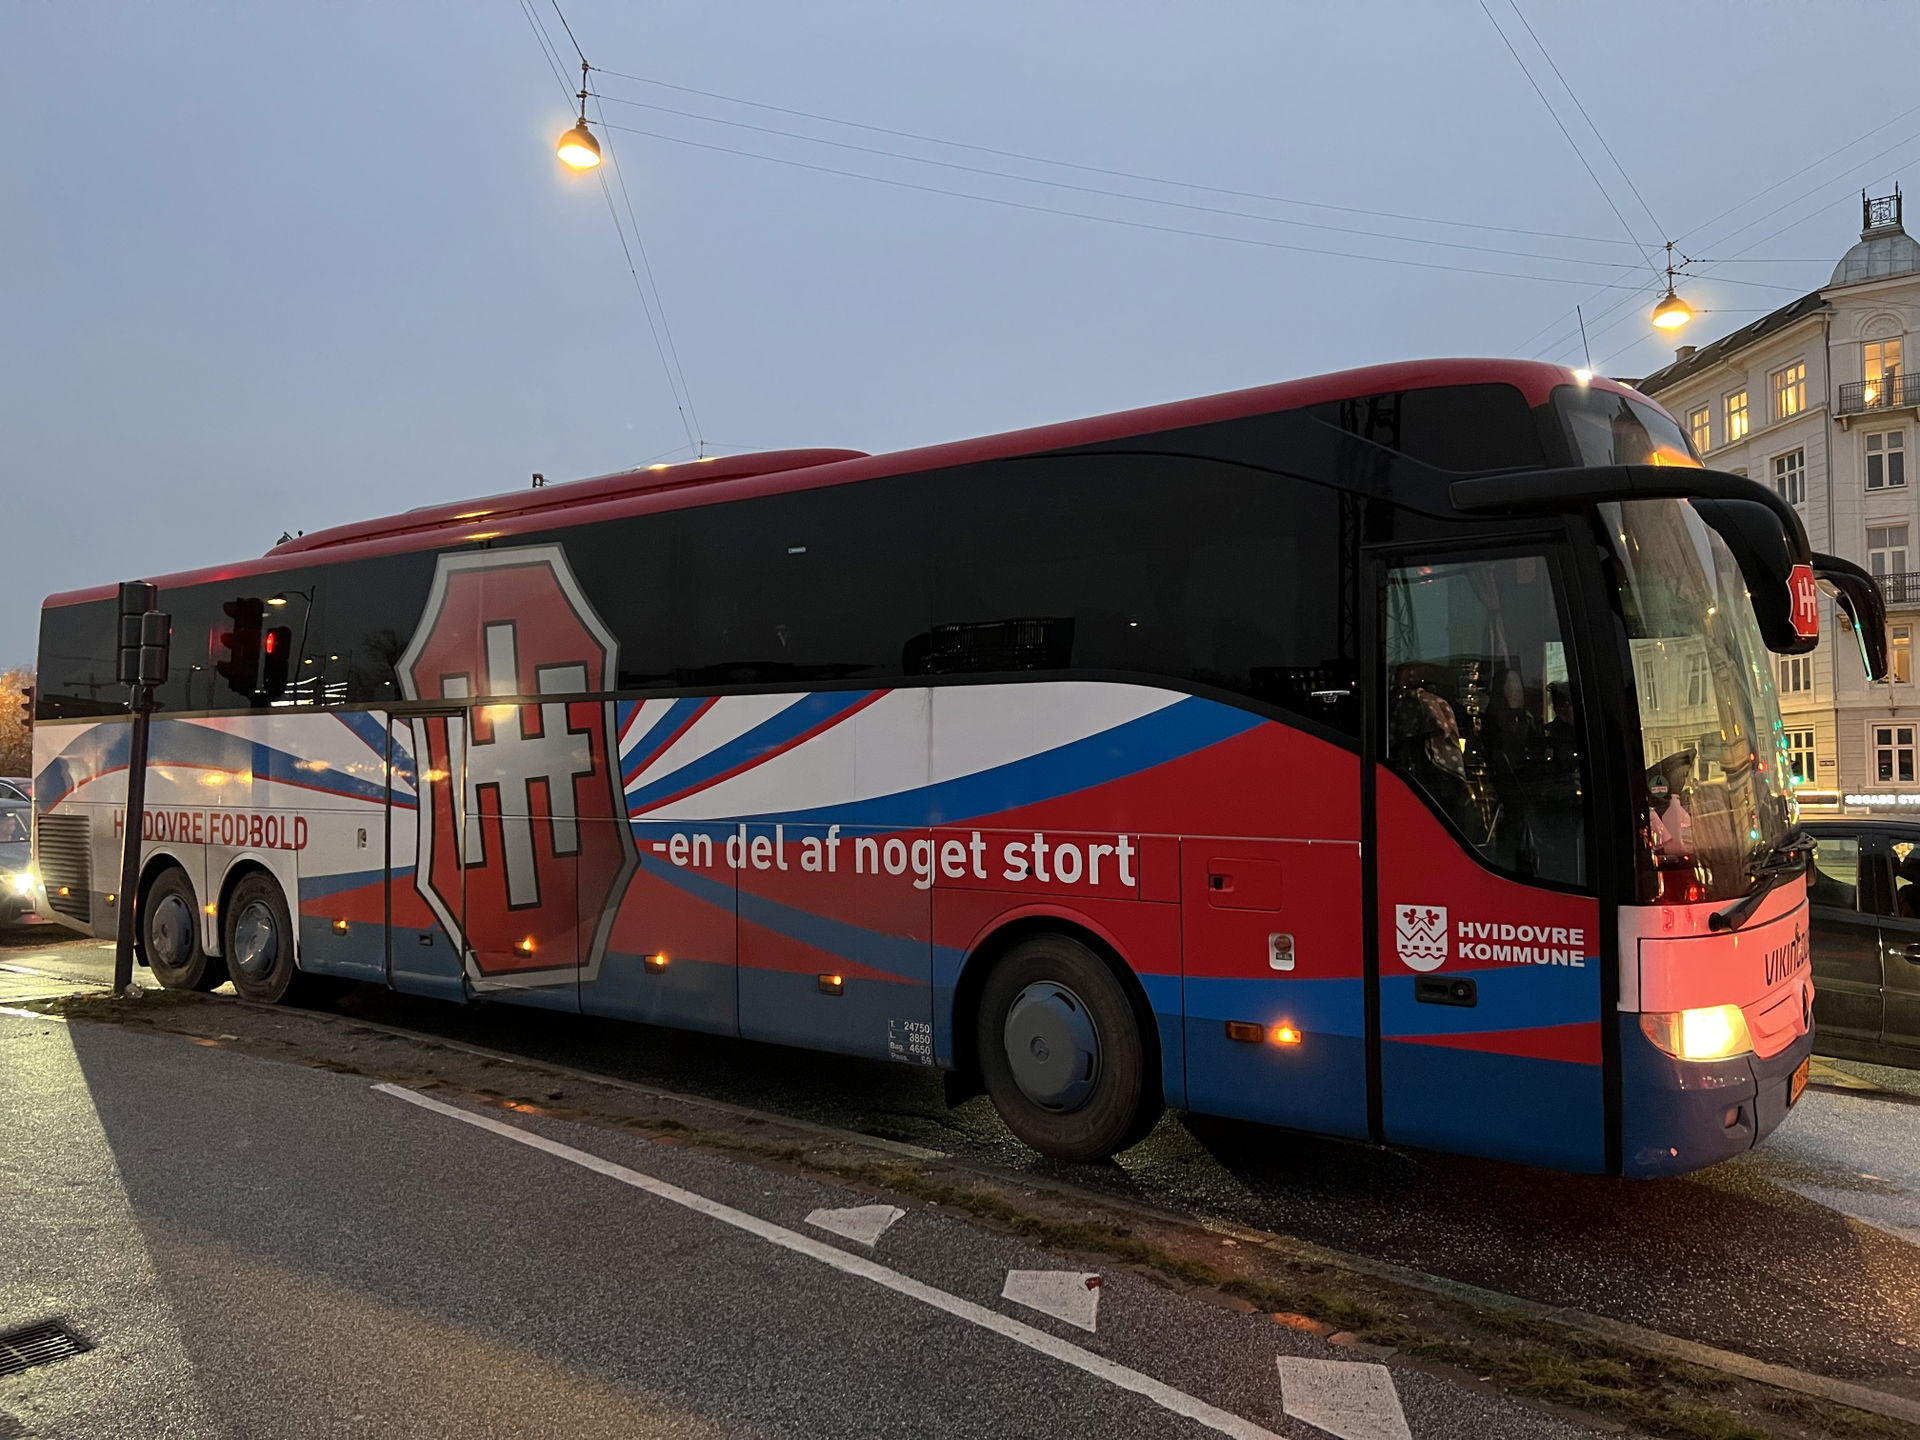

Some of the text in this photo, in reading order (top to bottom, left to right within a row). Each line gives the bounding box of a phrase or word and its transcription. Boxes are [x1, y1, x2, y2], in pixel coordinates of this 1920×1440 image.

[114, 809, 309, 850] HDOVRE FODBOLD
[726, 823, 788, 871] del
[800, 824, 841, 873] af
[855, 831, 988, 890] noget
[1002, 832, 1136, 887] stort
[1458, 921, 1585, 946] HVIDOVRE
[1458, 942, 1586, 968] KOMMUNE
[904, 1021, 930, 1033] 24750
[909, 1044, 931, 1055] 4650
[920, 1055, 932, 1066] 59
